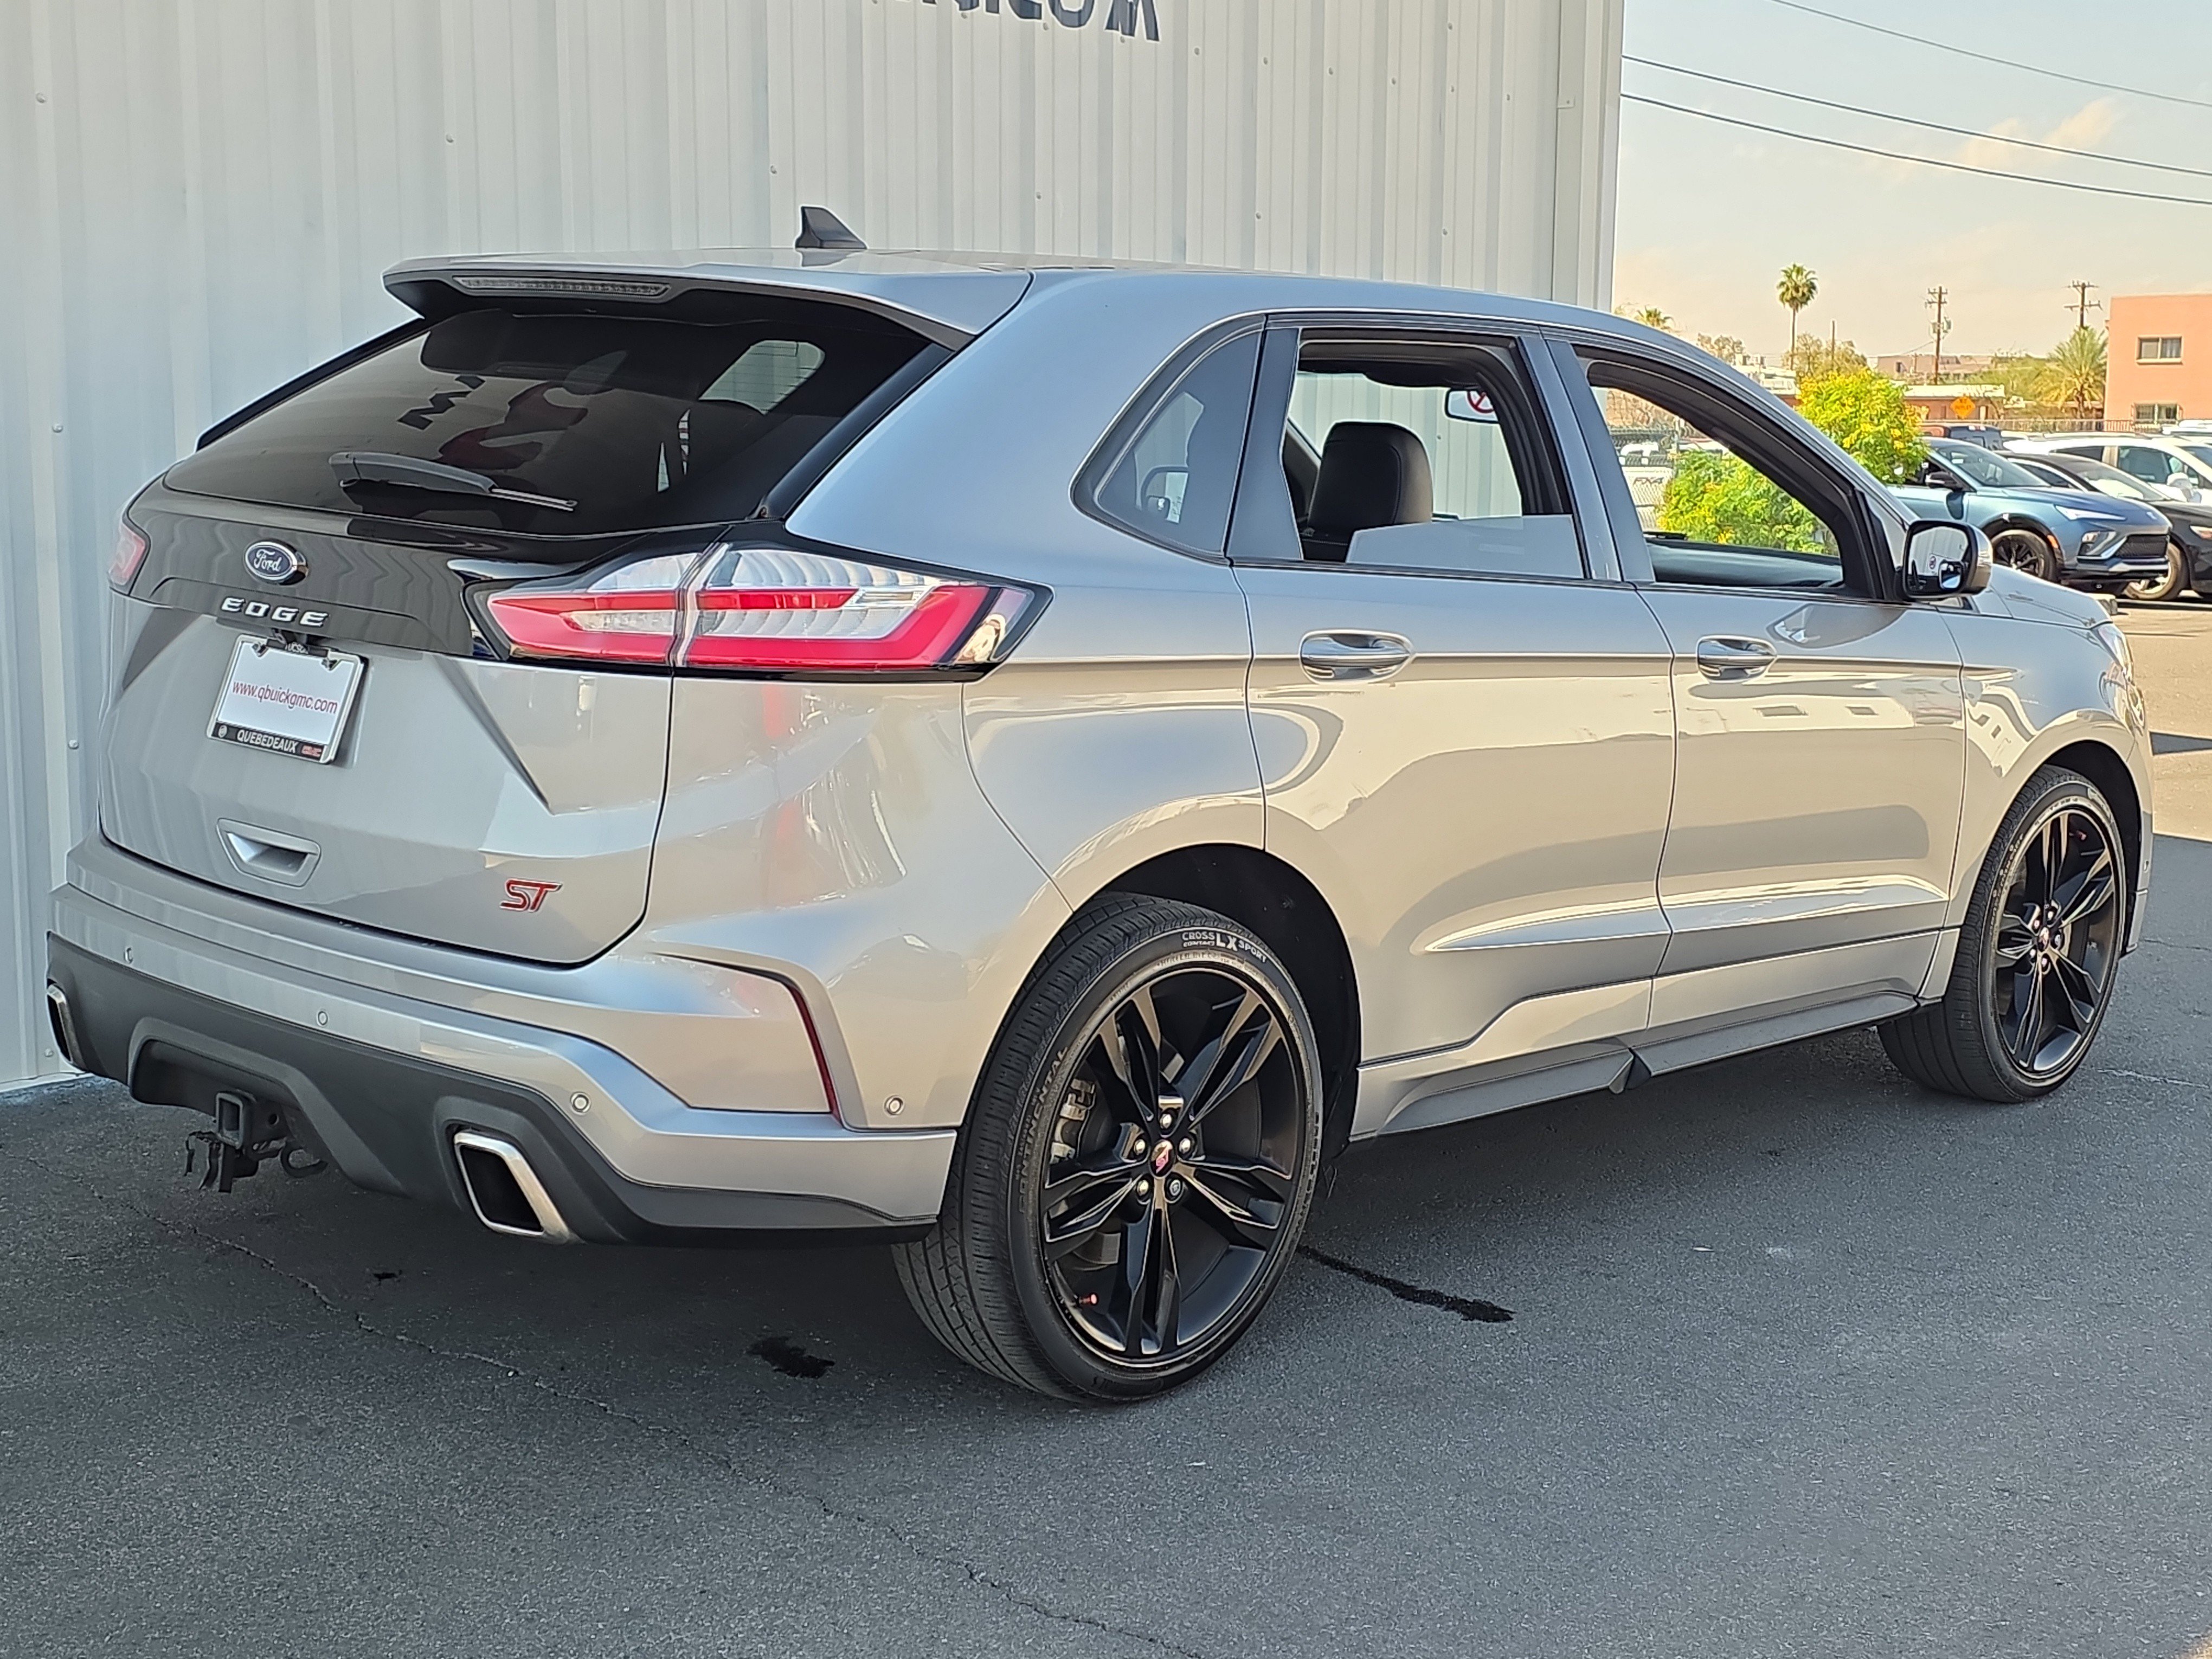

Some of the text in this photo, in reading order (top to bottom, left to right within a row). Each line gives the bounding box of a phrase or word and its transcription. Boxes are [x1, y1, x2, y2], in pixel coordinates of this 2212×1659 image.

[253, 549, 282, 572] Ford
[221, 597, 329, 627] EDGE
[232, 681, 338, 715] www.qbuickgmc.com
[236, 729, 299, 754] QUEBEDEAUX
[499, 878, 563, 912] ST
[1181, 931, 1216, 941] CROSS
[1216, 933, 1238, 952] LX
[1238, 939, 1268, 963] SPORT
[1018, 1046, 1069, 1213] CONTINENTAL
